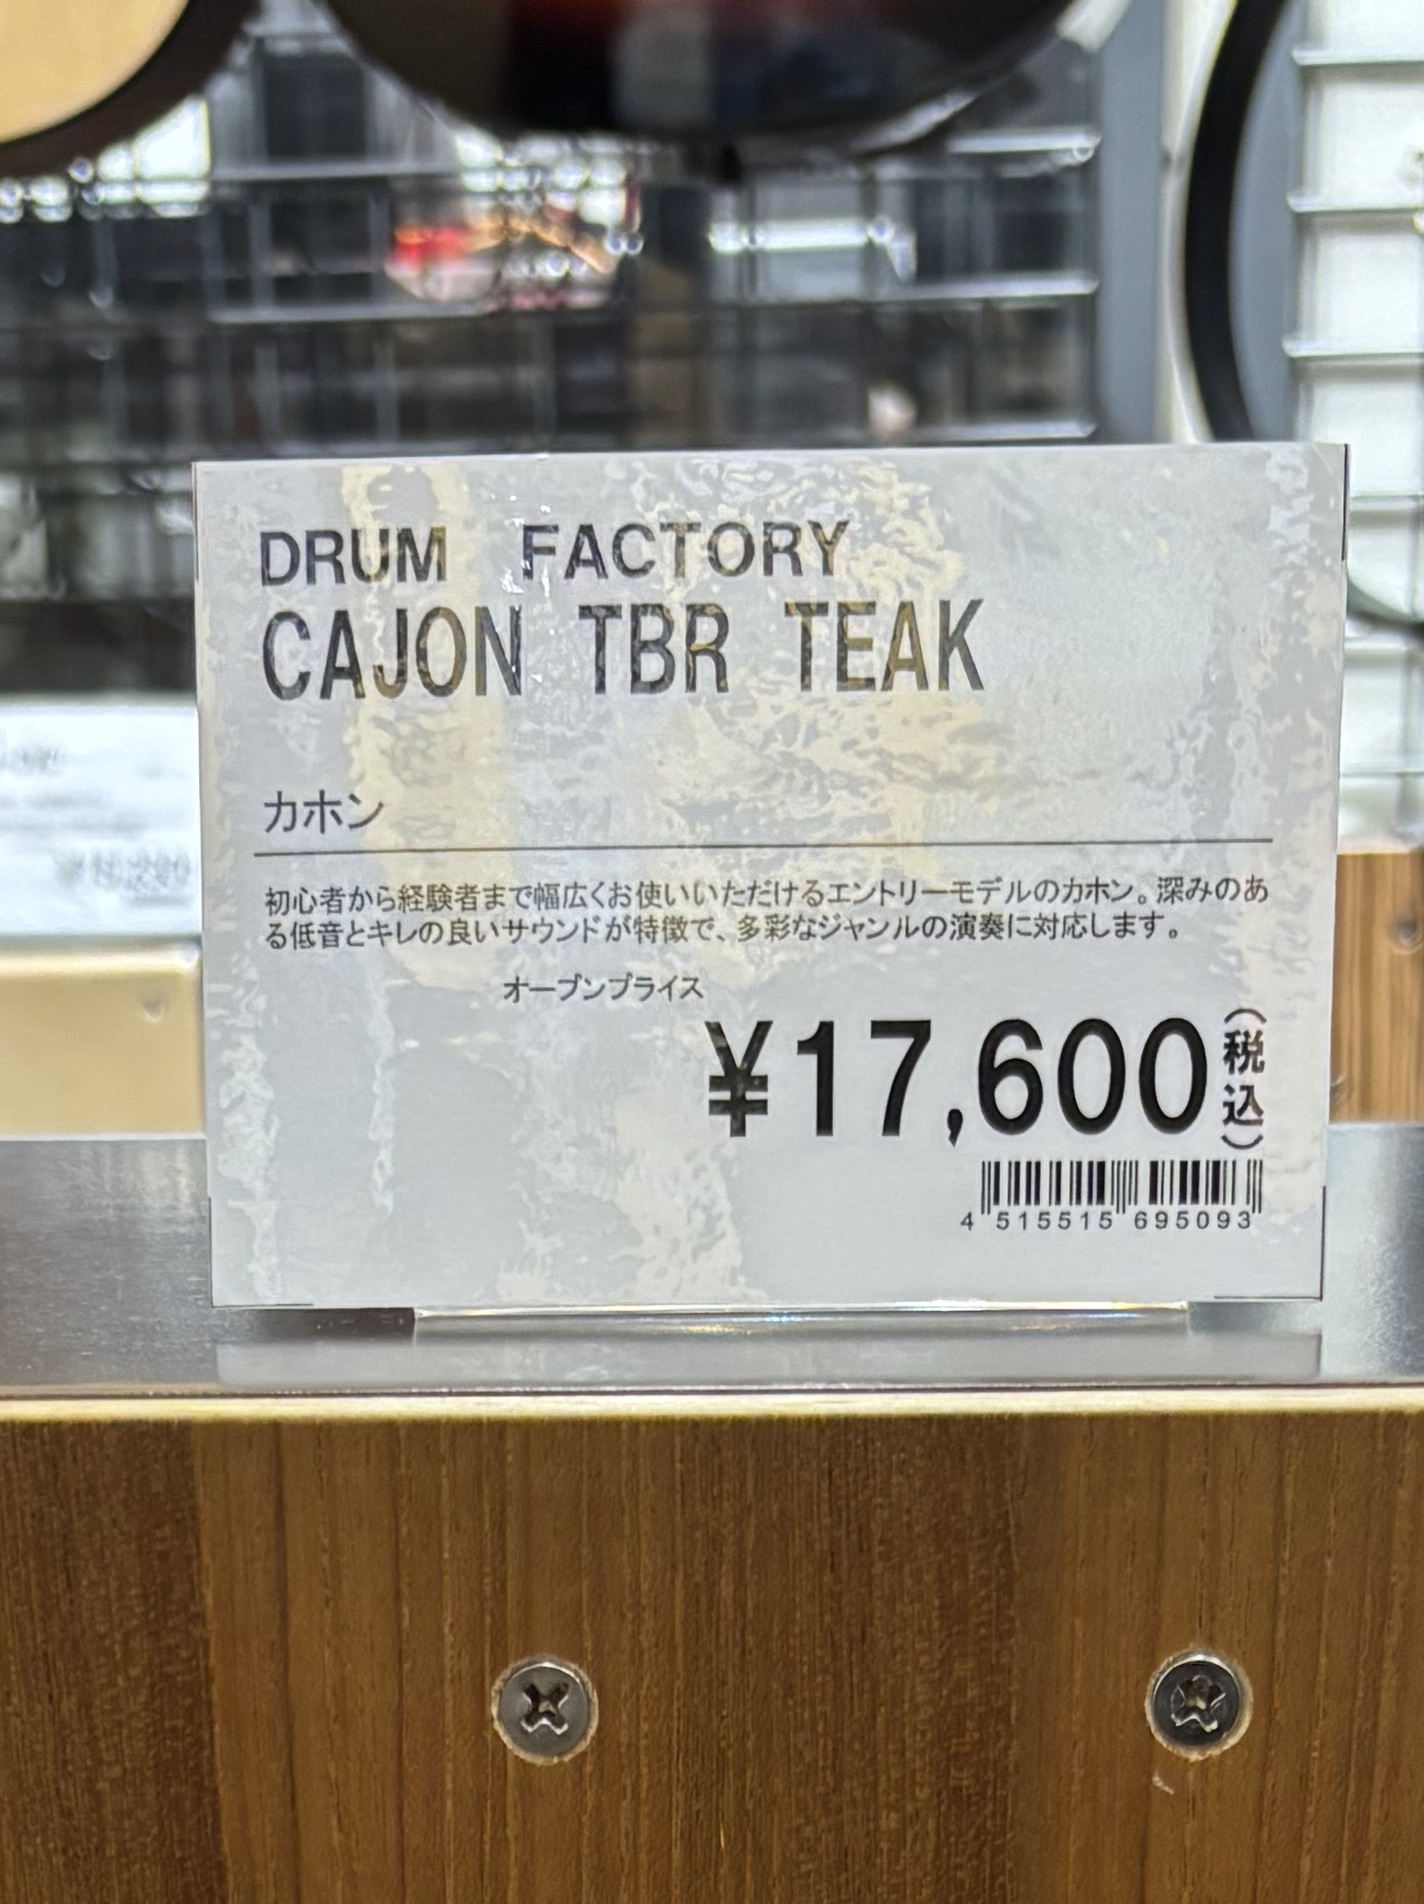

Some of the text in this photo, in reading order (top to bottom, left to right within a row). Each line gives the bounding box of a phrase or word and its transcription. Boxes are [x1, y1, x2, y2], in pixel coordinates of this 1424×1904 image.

[260, 520, 850, 587] DRUM FACTORY
[263, 599, 984, 700] CAJON TBR TEAK
[264, 790, 384, 834] カホン
[265, 874, 1268, 911] 初心者から経験者まで幅広くお使いいただけるエントリーモデルのカホン。深みのあ
[266, 912, 1178, 950] る低音とキレの良いサウンドが特徴で、多彩なジャンルの演奏に対応します。
[504, 972, 703, 1003] オープンプライス
[704, 1017, 1208, 1146] ¥17,600
[960, 1209, 1254, 1231] 4 515515 695093
